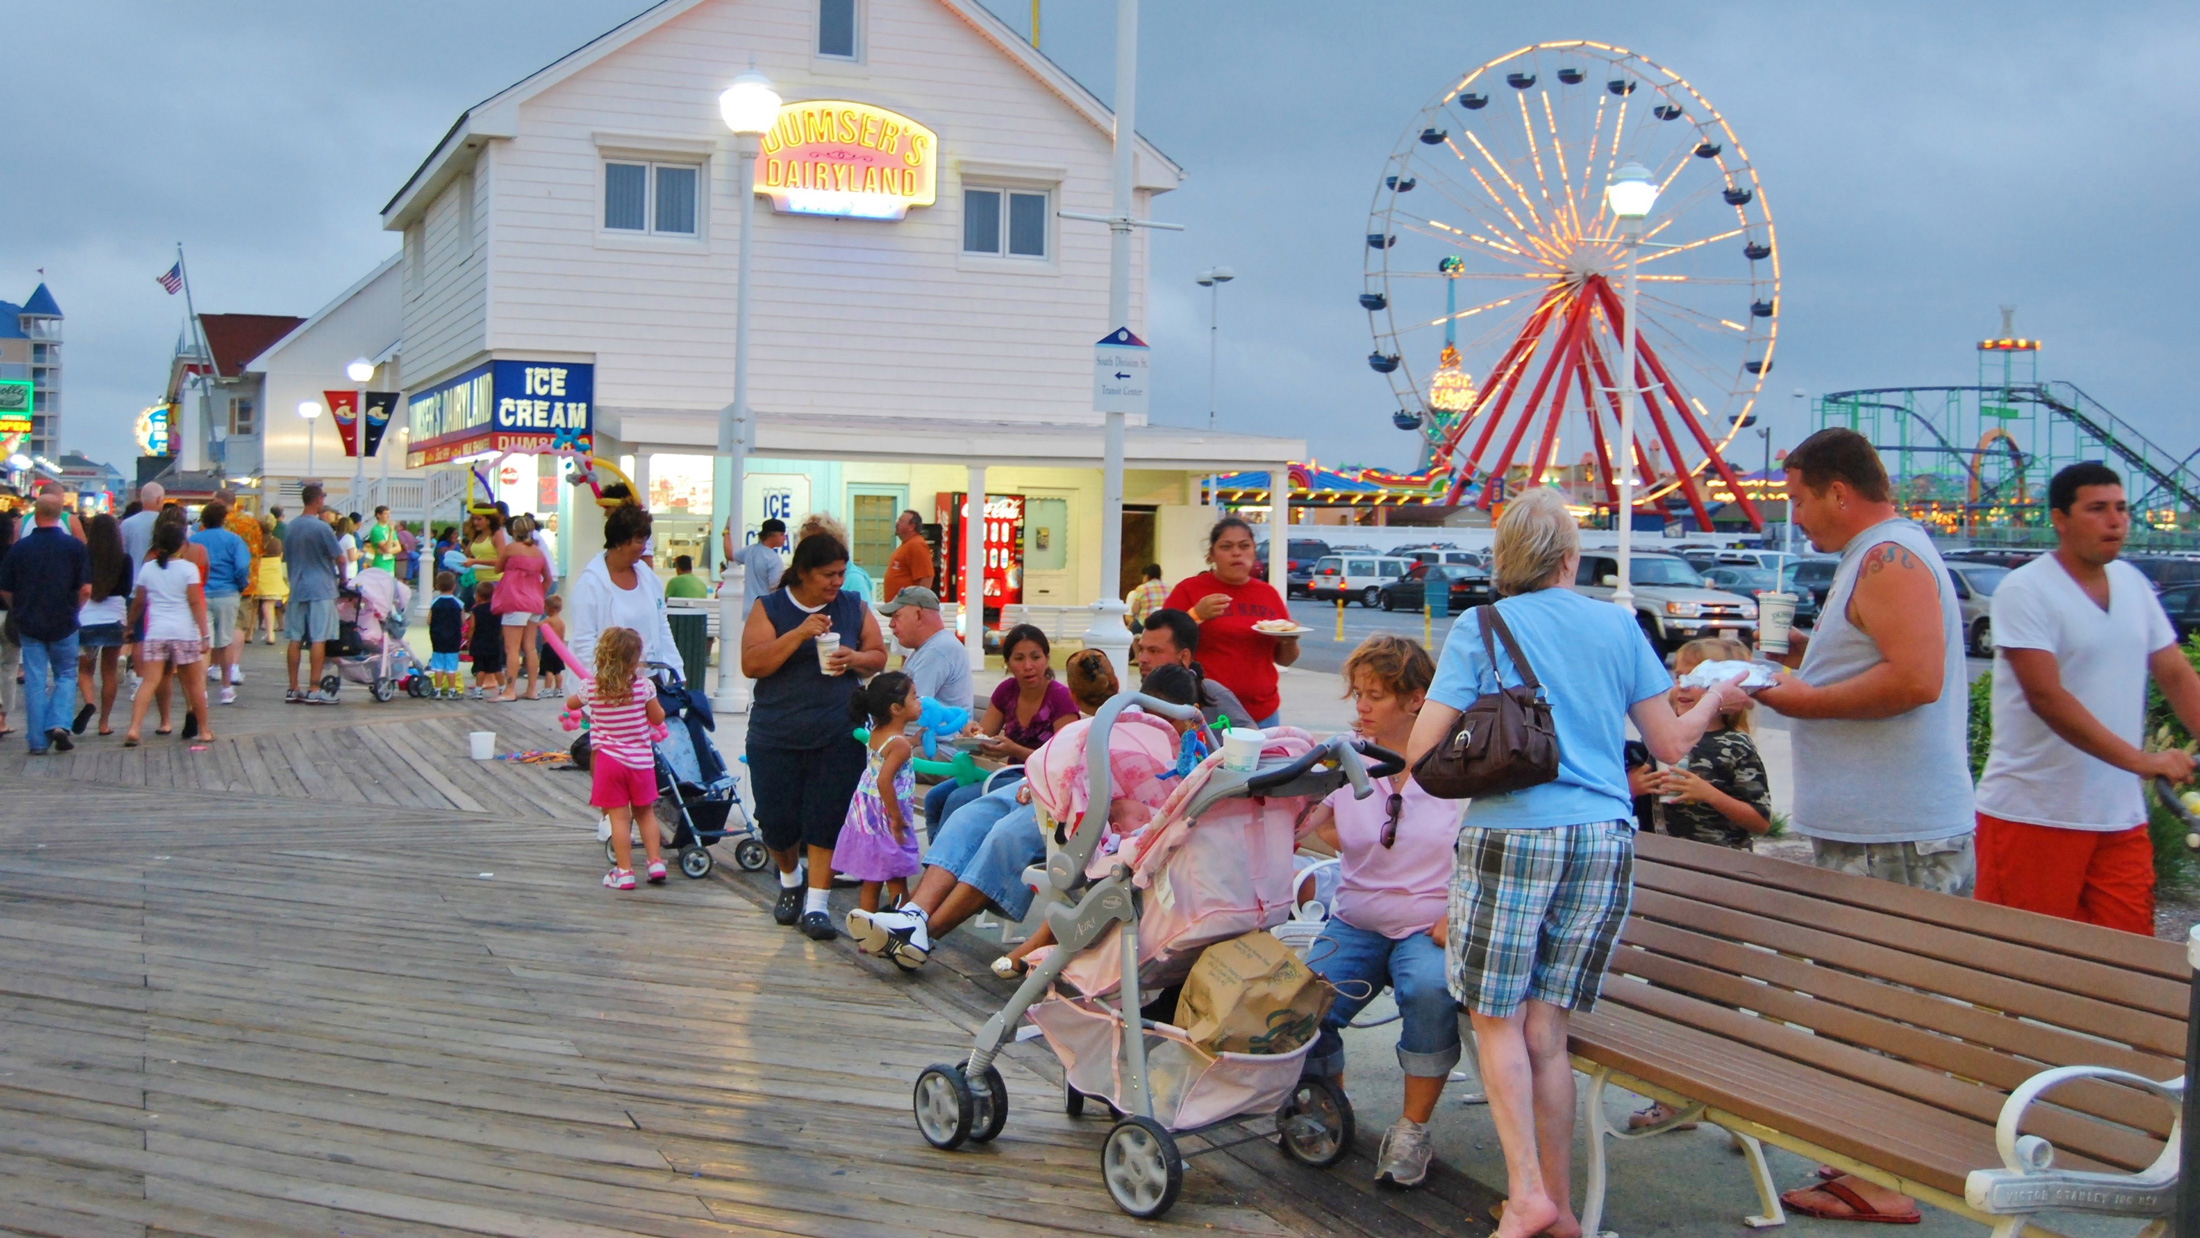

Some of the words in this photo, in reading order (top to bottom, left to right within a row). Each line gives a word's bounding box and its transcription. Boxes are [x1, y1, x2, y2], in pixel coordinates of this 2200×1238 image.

[766, 157, 918, 197] DAIRYLAND
[1096, 355, 1114, 367] South
[1115, 355, 1139, 368] Division
[525, 367, 568, 397] ICE
[1101, 384, 1122, 396] Transit
[1123, 385, 1143, 397] Center
[442, 372, 494, 435] DAIRYLAND
[499, 397, 588, 430] CREAM
[763, 490, 791, 519] ICE
[2006, 1189, 2049, 1202] VICTOR
[2055, 1189, 2111, 1204] STANLEY
